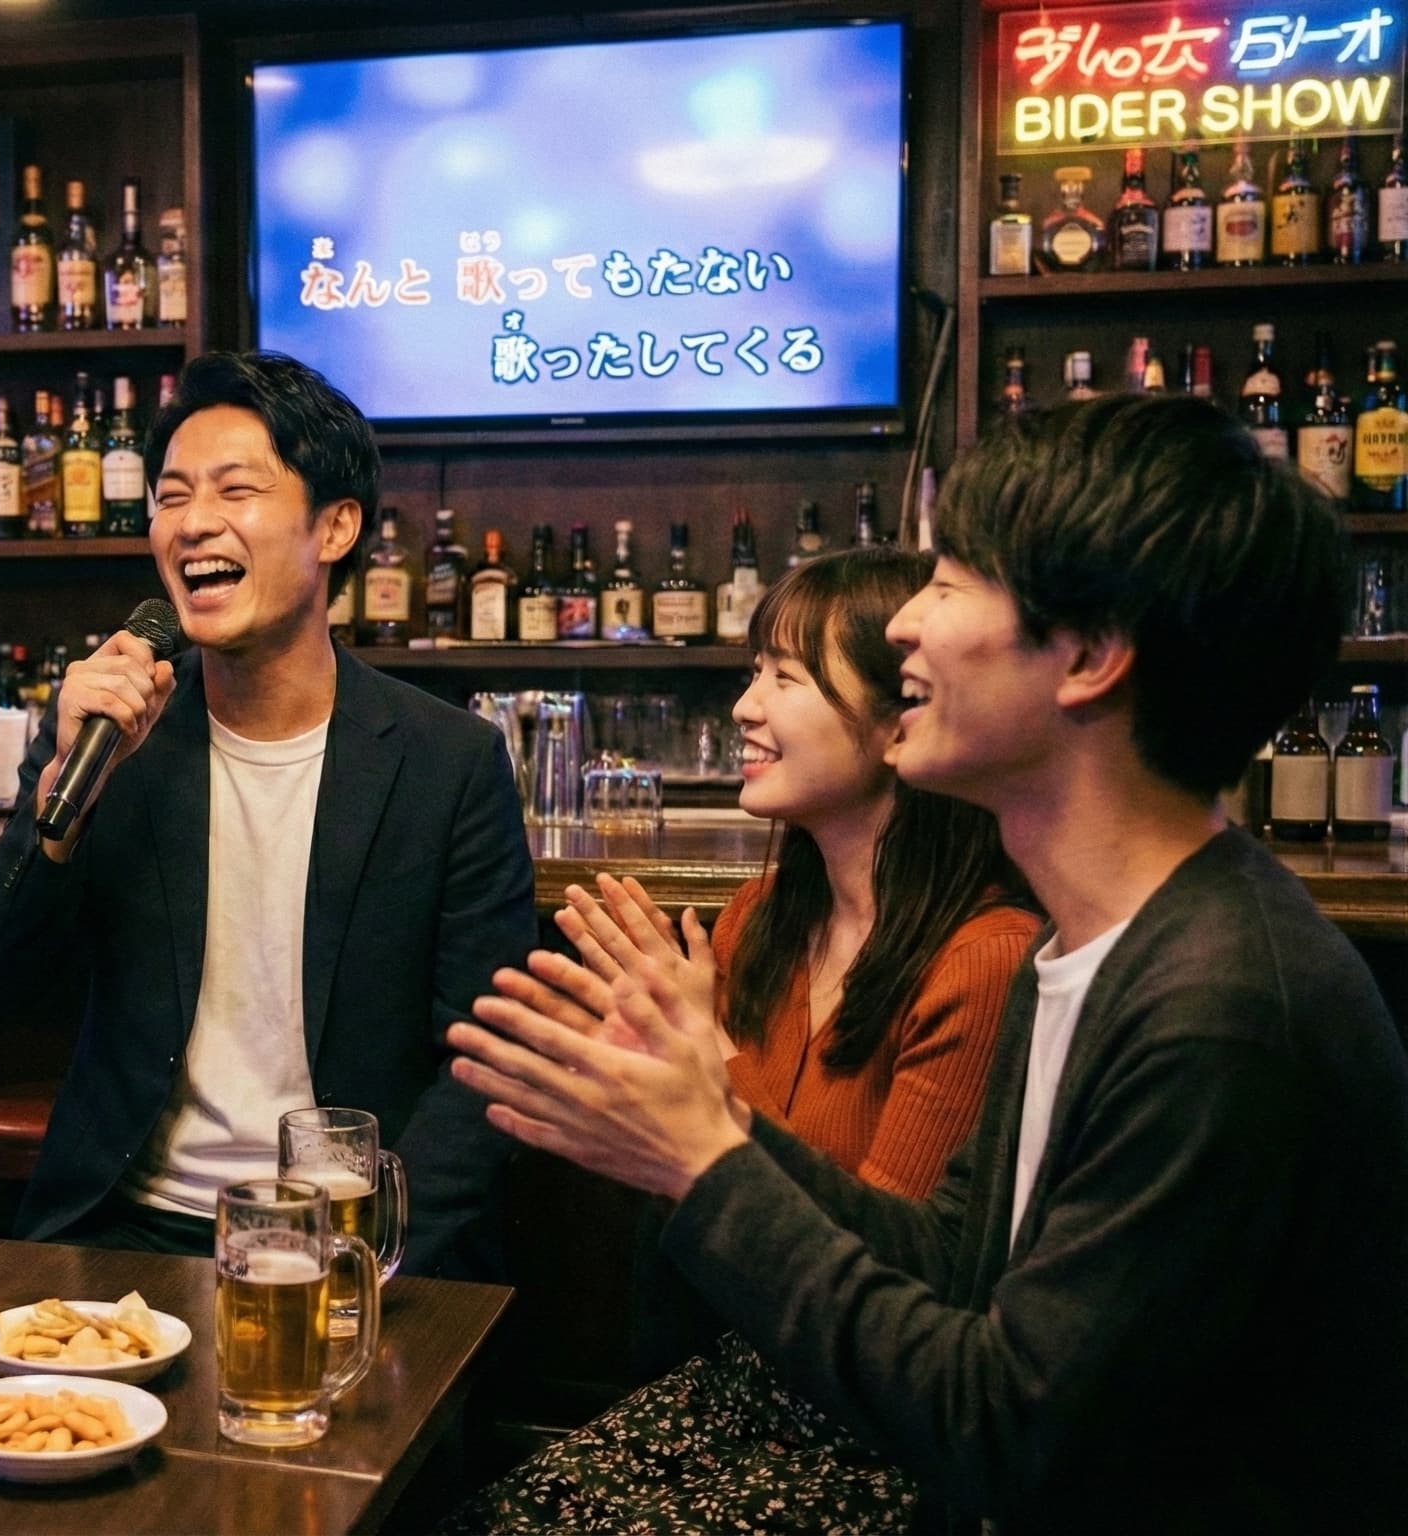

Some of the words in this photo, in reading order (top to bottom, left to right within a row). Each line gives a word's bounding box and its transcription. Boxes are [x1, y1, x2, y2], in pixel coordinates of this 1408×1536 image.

[1014, 88, 1187, 143] BIDER
[1201, 75, 1392, 134] SHOW
[300, 259, 431, 311] なんと
[456, 245, 794, 306] 歌ってもたない
[491, 325, 826, 384] 歌ったしてくる
